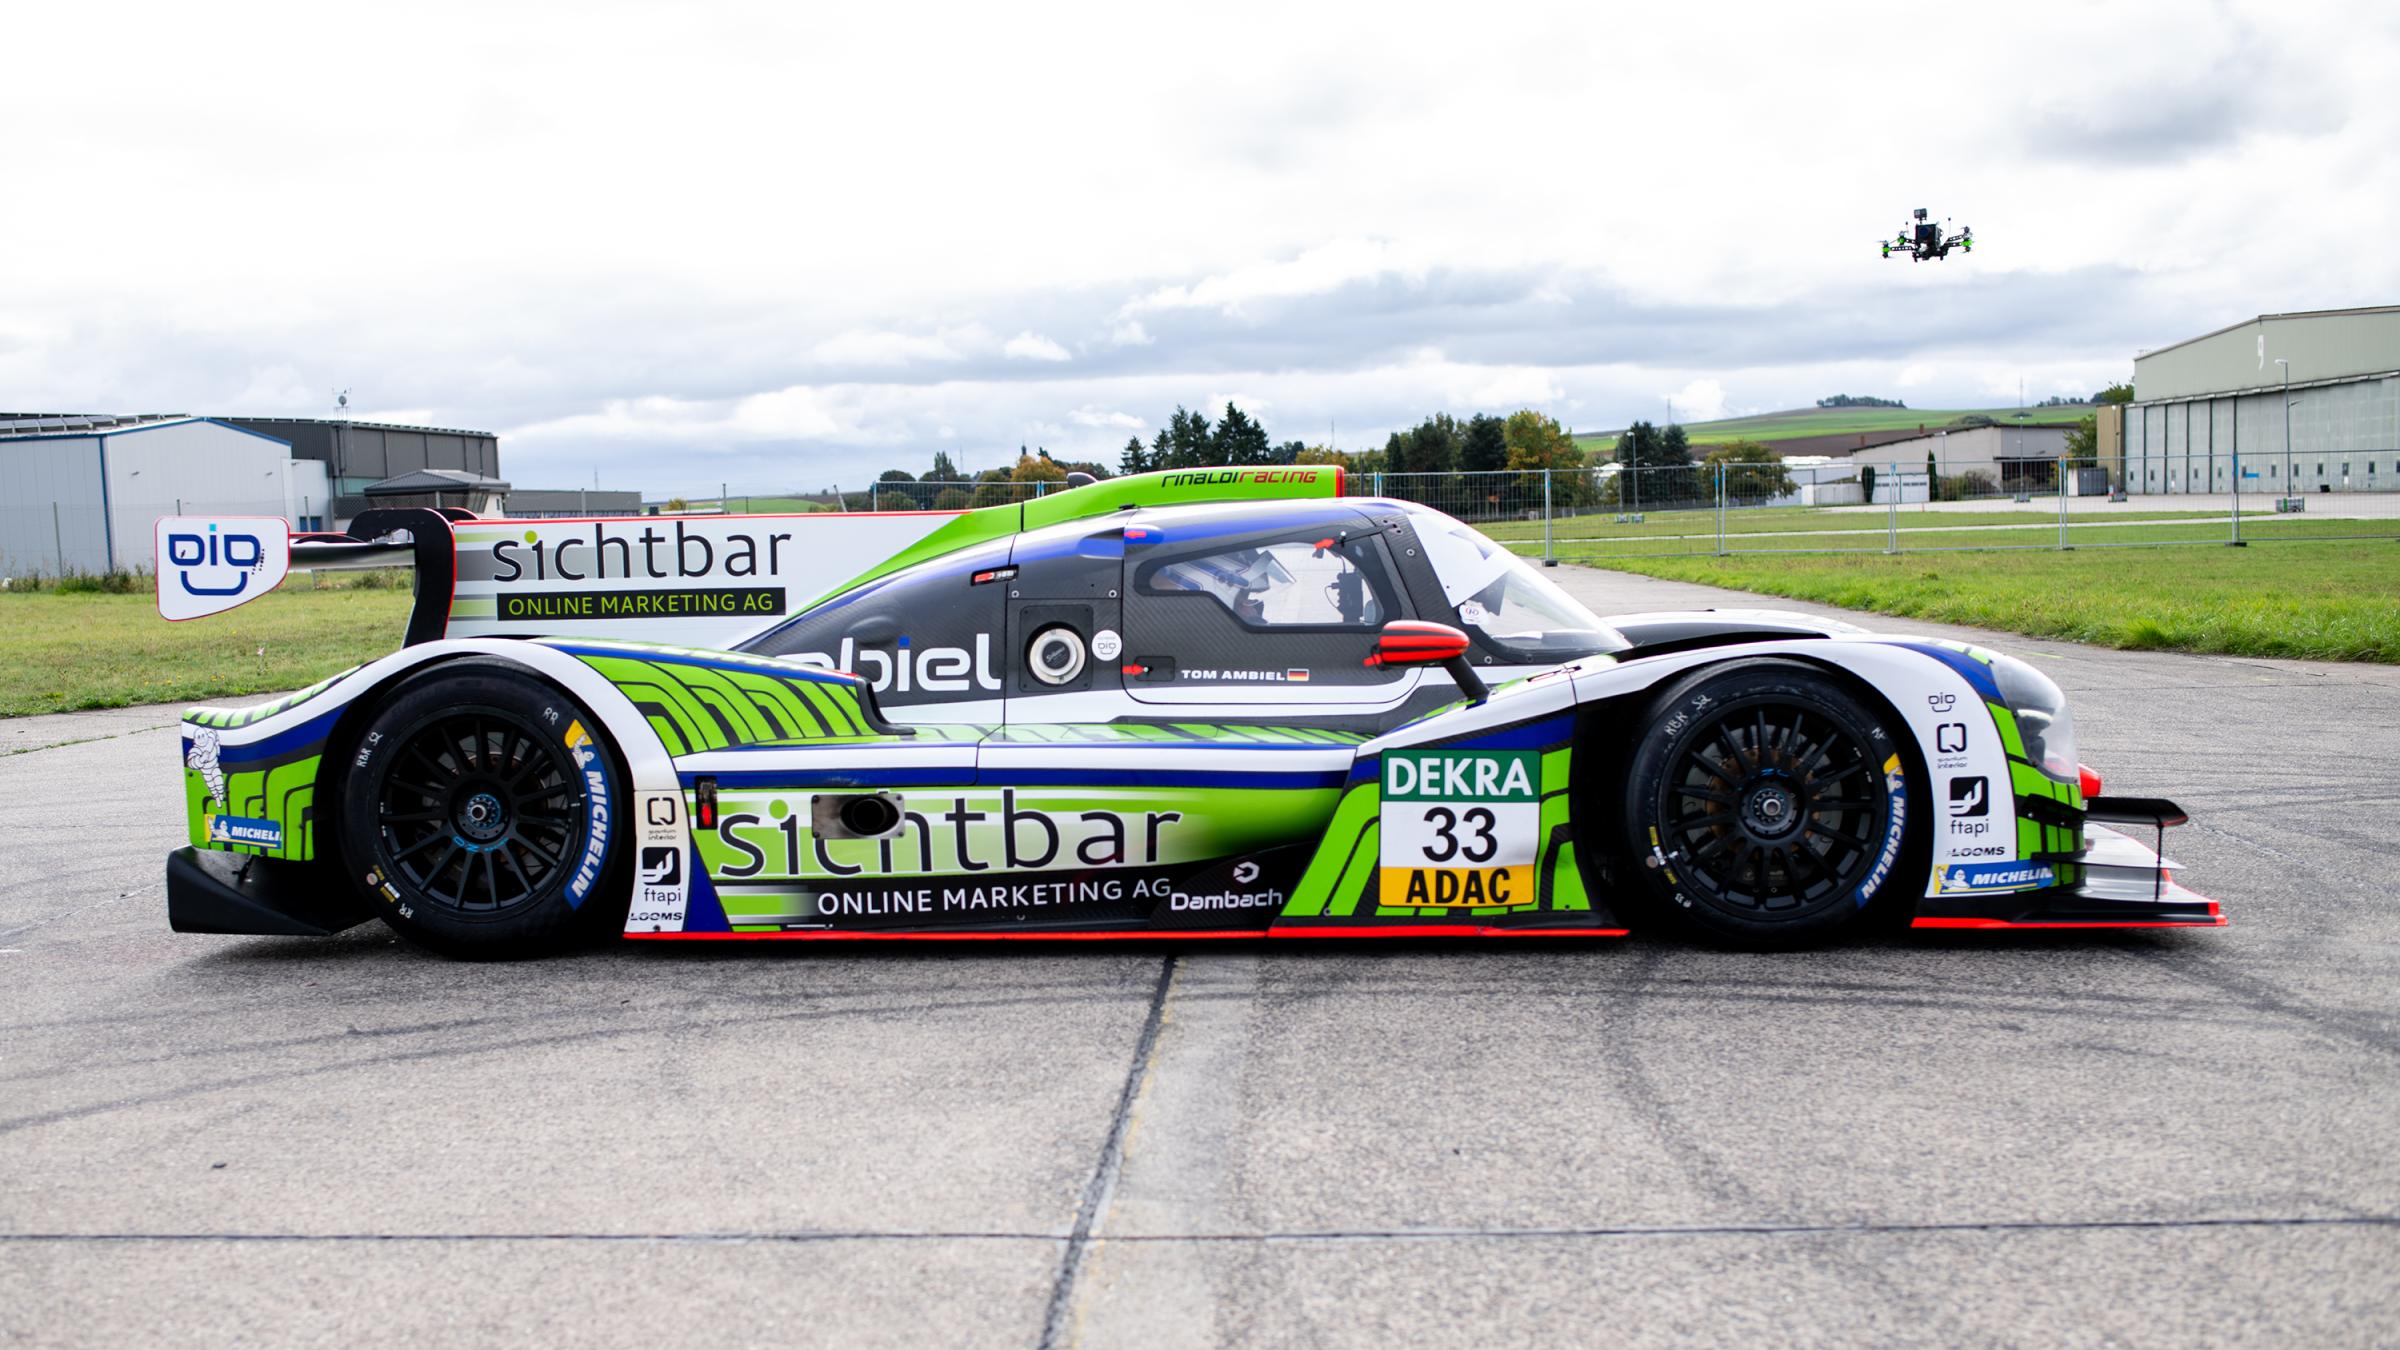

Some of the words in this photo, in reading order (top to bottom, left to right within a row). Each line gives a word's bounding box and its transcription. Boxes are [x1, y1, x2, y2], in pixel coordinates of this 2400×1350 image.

[492, 520, 792, 582] sichtbar
[508, 597, 594, 616] ONLINE
[601, 593, 736, 614] MARKETING
[743, 593, 774, 611] AG
[1181, 669, 1217, 679] TOM
[1221, 670, 1285, 681] AMBIEL
[1388, 757, 1533, 797] DEKRA
[231, 826, 282, 841] MICHELI
[571, 771, 609, 898] MICHELIN
[720, 787, 1181, 877] sichtbar
[1422, 806, 1498, 863] 33
[1950, 819, 1990, 838] ftapi
[1861, 796, 1905, 899] MICHELIN
[1405, 868, 1511, 904] ADAC
[1971, 867, 2054, 885] MICHELIN
[644, 887, 682, 905] ftapi
[818, 890, 933, 915] ONLINE
[943, 881, 1122, 911] MARKETING
[1132, 878, 1171, 898] AG
[1171, 888, 1283, 911] Dambach
